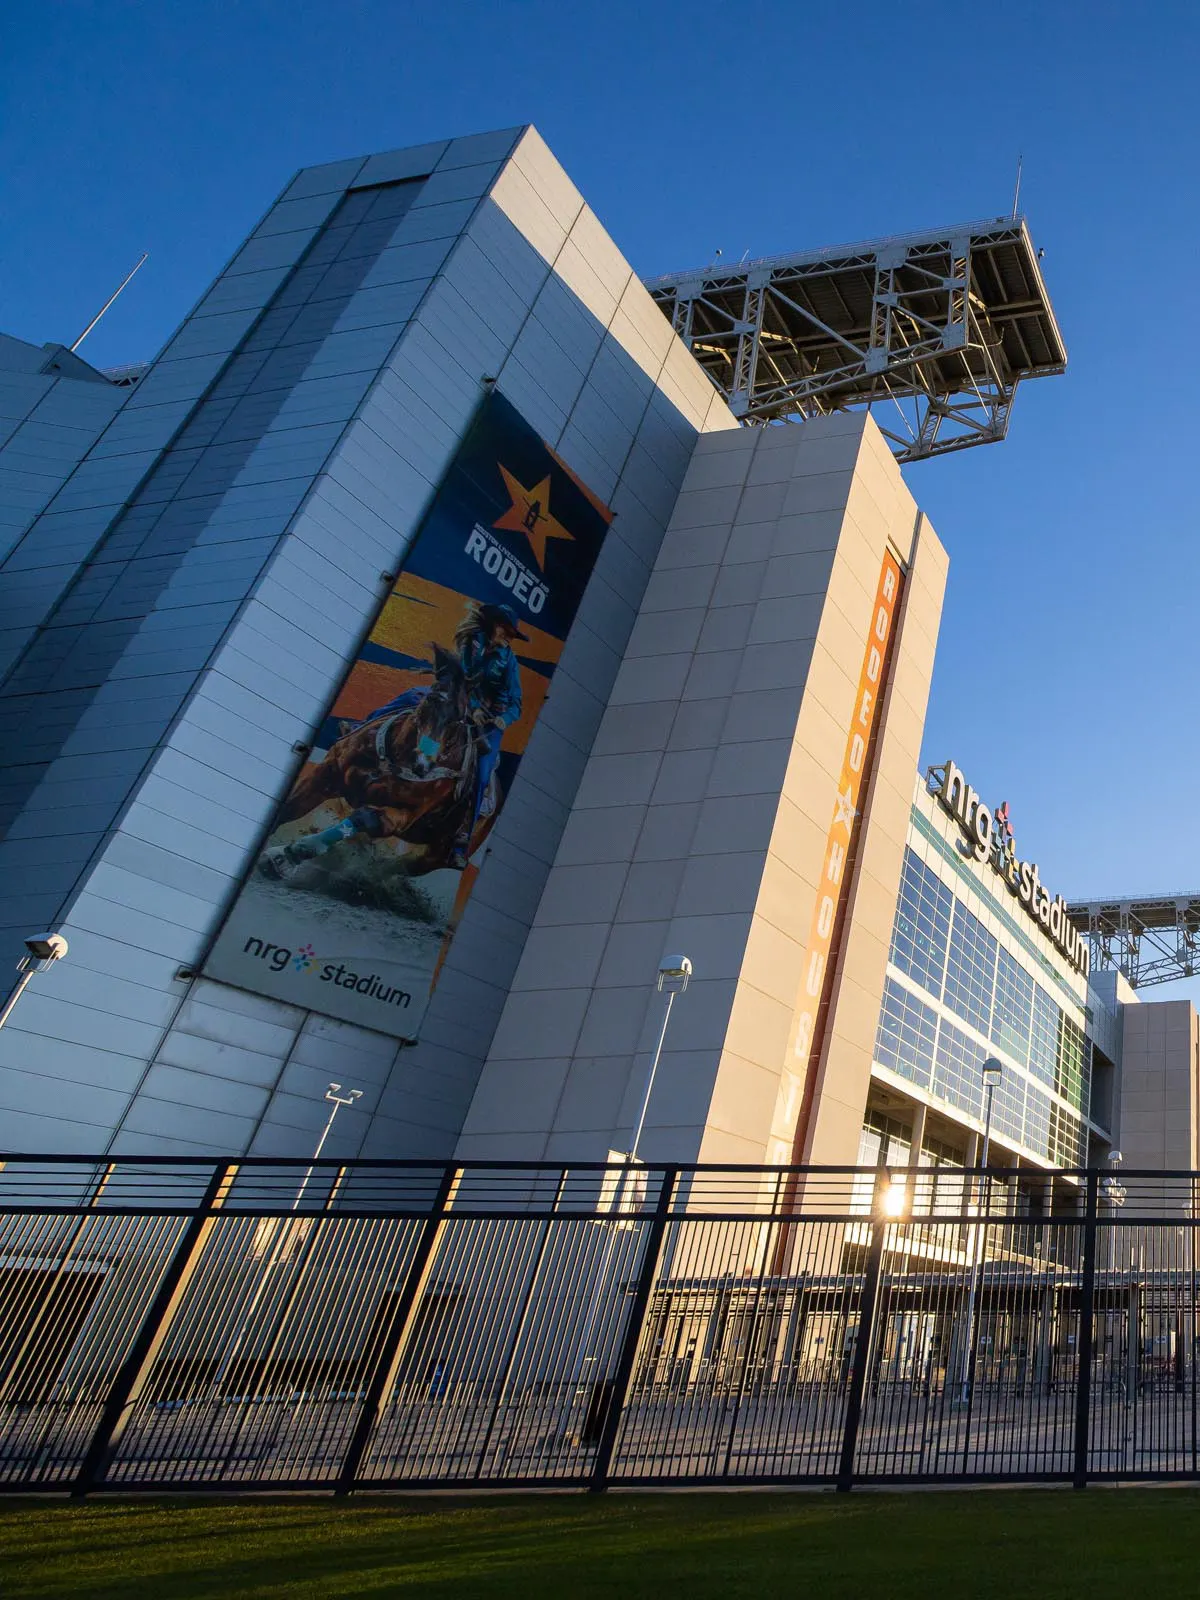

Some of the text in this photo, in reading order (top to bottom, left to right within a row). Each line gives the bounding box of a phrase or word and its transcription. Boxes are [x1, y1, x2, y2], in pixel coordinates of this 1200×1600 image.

[464, 528, 546, 614] RODEO
[849, 565, 896, 774] RODEO
[942, 760, 1090, 976] nrg stadium
[243, 936, 412, 1009] nrg stadium
